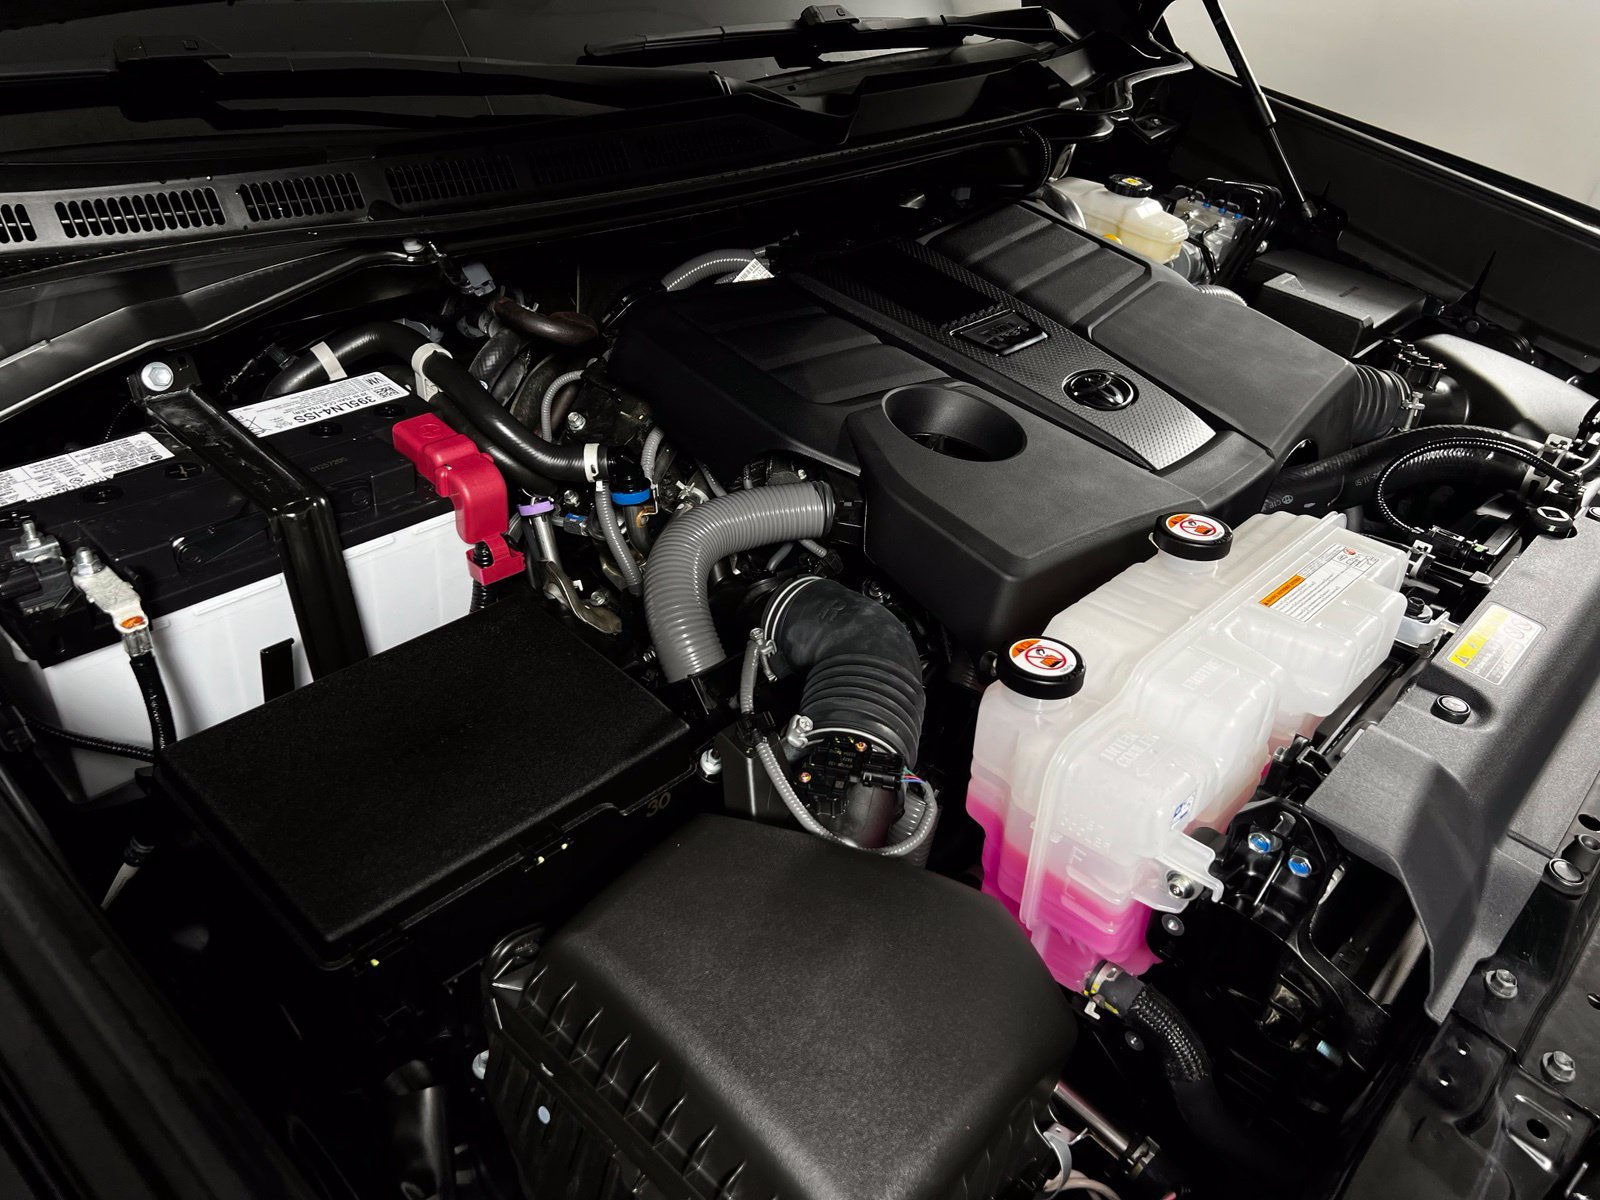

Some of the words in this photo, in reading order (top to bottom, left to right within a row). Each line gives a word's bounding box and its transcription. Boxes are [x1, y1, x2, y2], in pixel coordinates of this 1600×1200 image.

[365, 376, 383, 386] VM
[293, 395, 377, 424] 395LN4-ISS
[646, 792, 671, 818] 30
